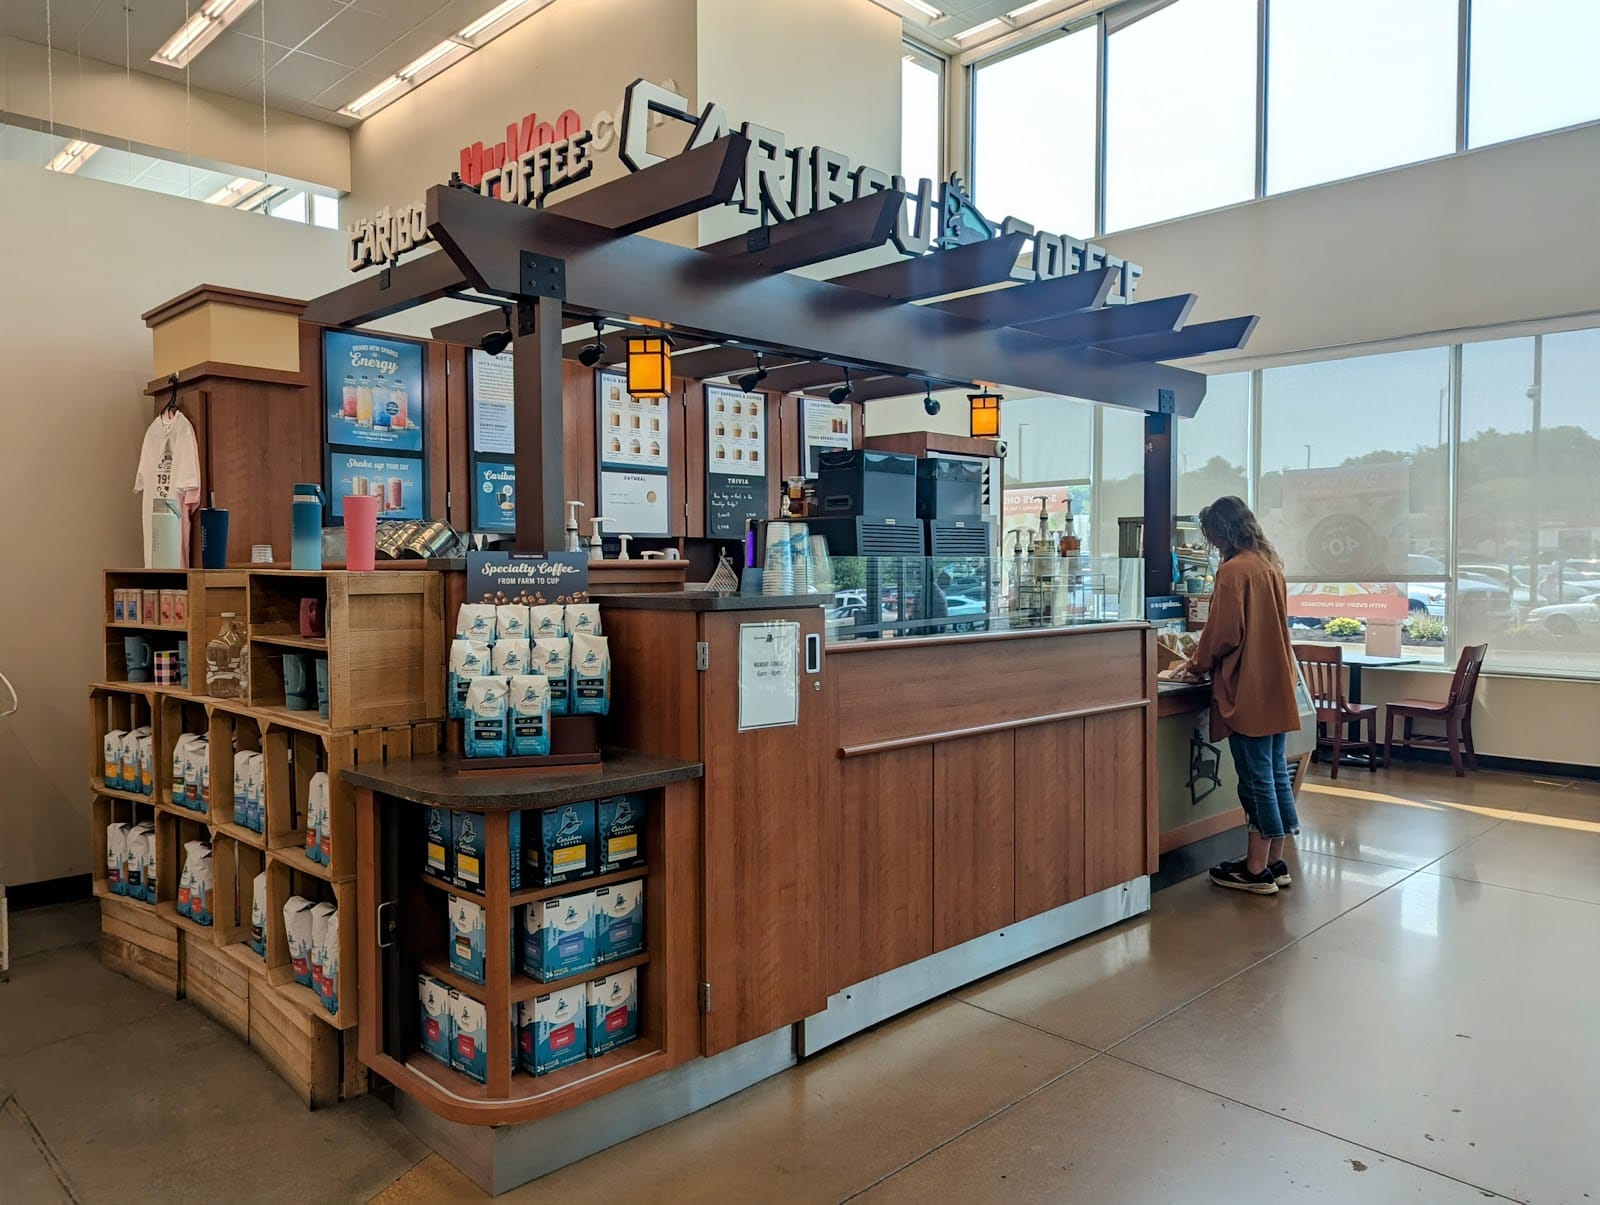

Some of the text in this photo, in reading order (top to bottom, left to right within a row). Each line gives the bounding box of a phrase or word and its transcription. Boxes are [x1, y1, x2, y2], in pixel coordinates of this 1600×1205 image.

[346, 129, 593, 272] CARIBO COFFEE
[350, 352, 399, 374] Energy
[346, 458, 372, 468] Shake
[374, 462, 384, 471] up
[482, 562, 580, 576] Specialty Coffee
[557, 834, 582, 844] Caribou
